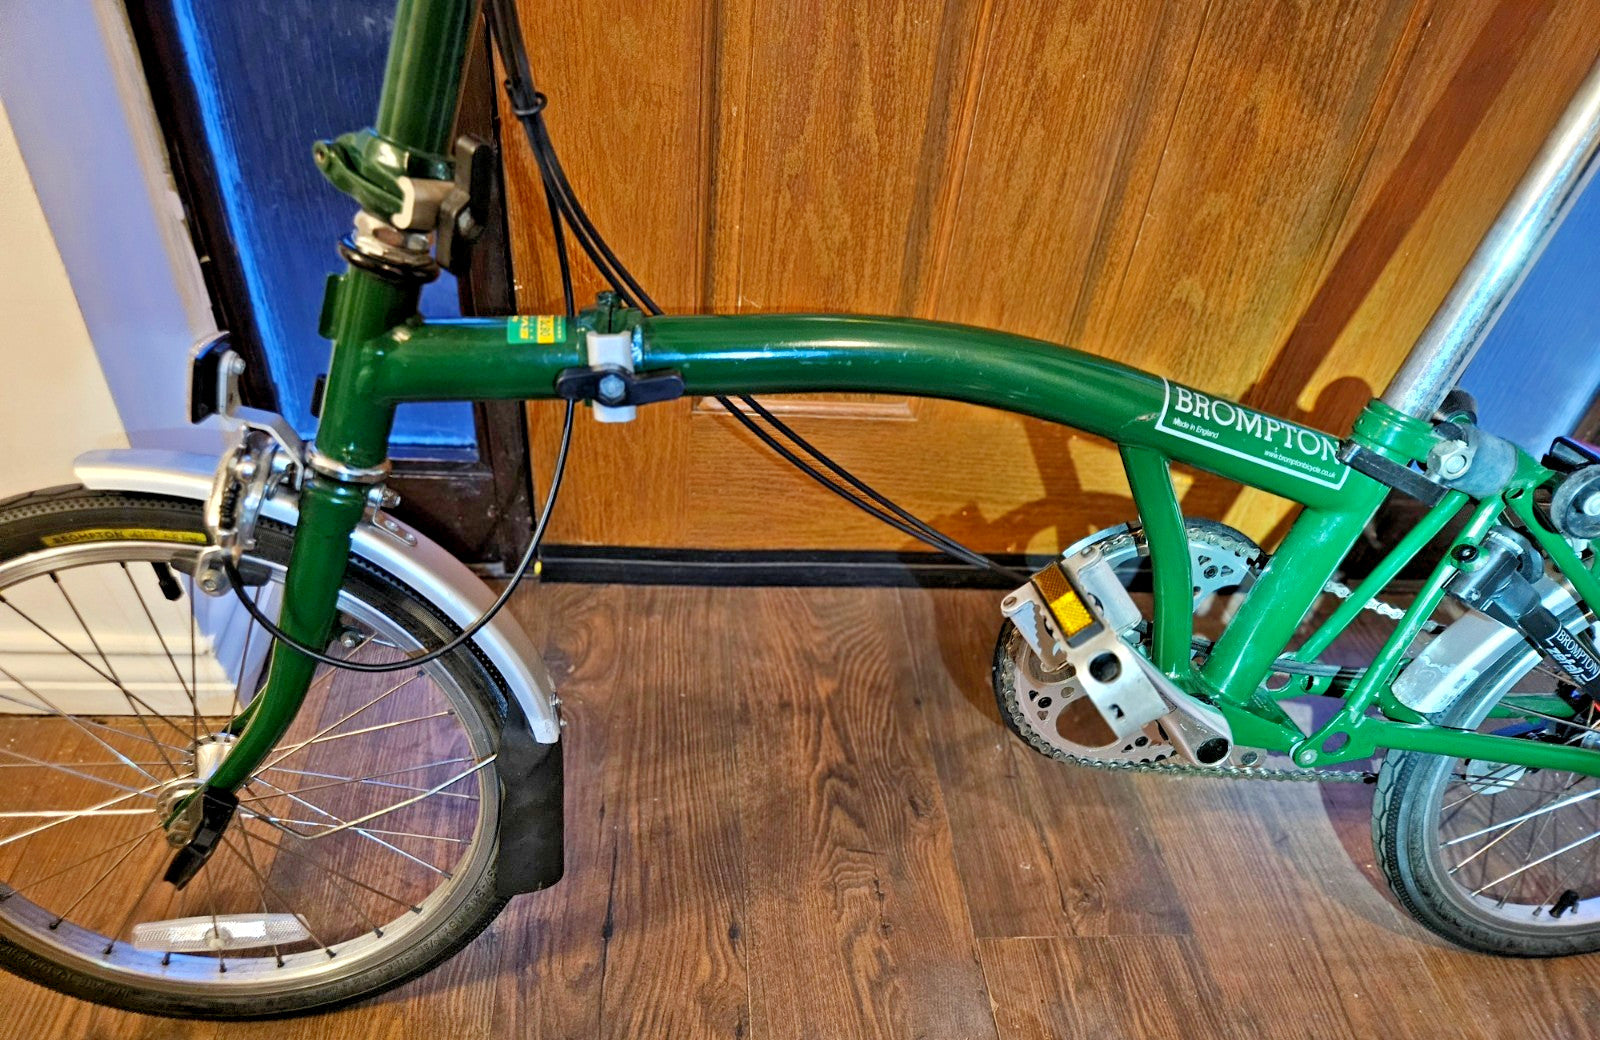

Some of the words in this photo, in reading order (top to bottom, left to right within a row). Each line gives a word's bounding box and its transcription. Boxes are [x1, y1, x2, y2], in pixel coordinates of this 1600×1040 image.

[1172, 417, 1190, 429] Made
[1196, 425, 1219, 439] England
[1174, 386, 1340, 465] BROMPTON
[1263, 449, 1337, 479] www.bromptonbicycle.co.uk
[1556, 629, 1600, 675] BROMPTON
